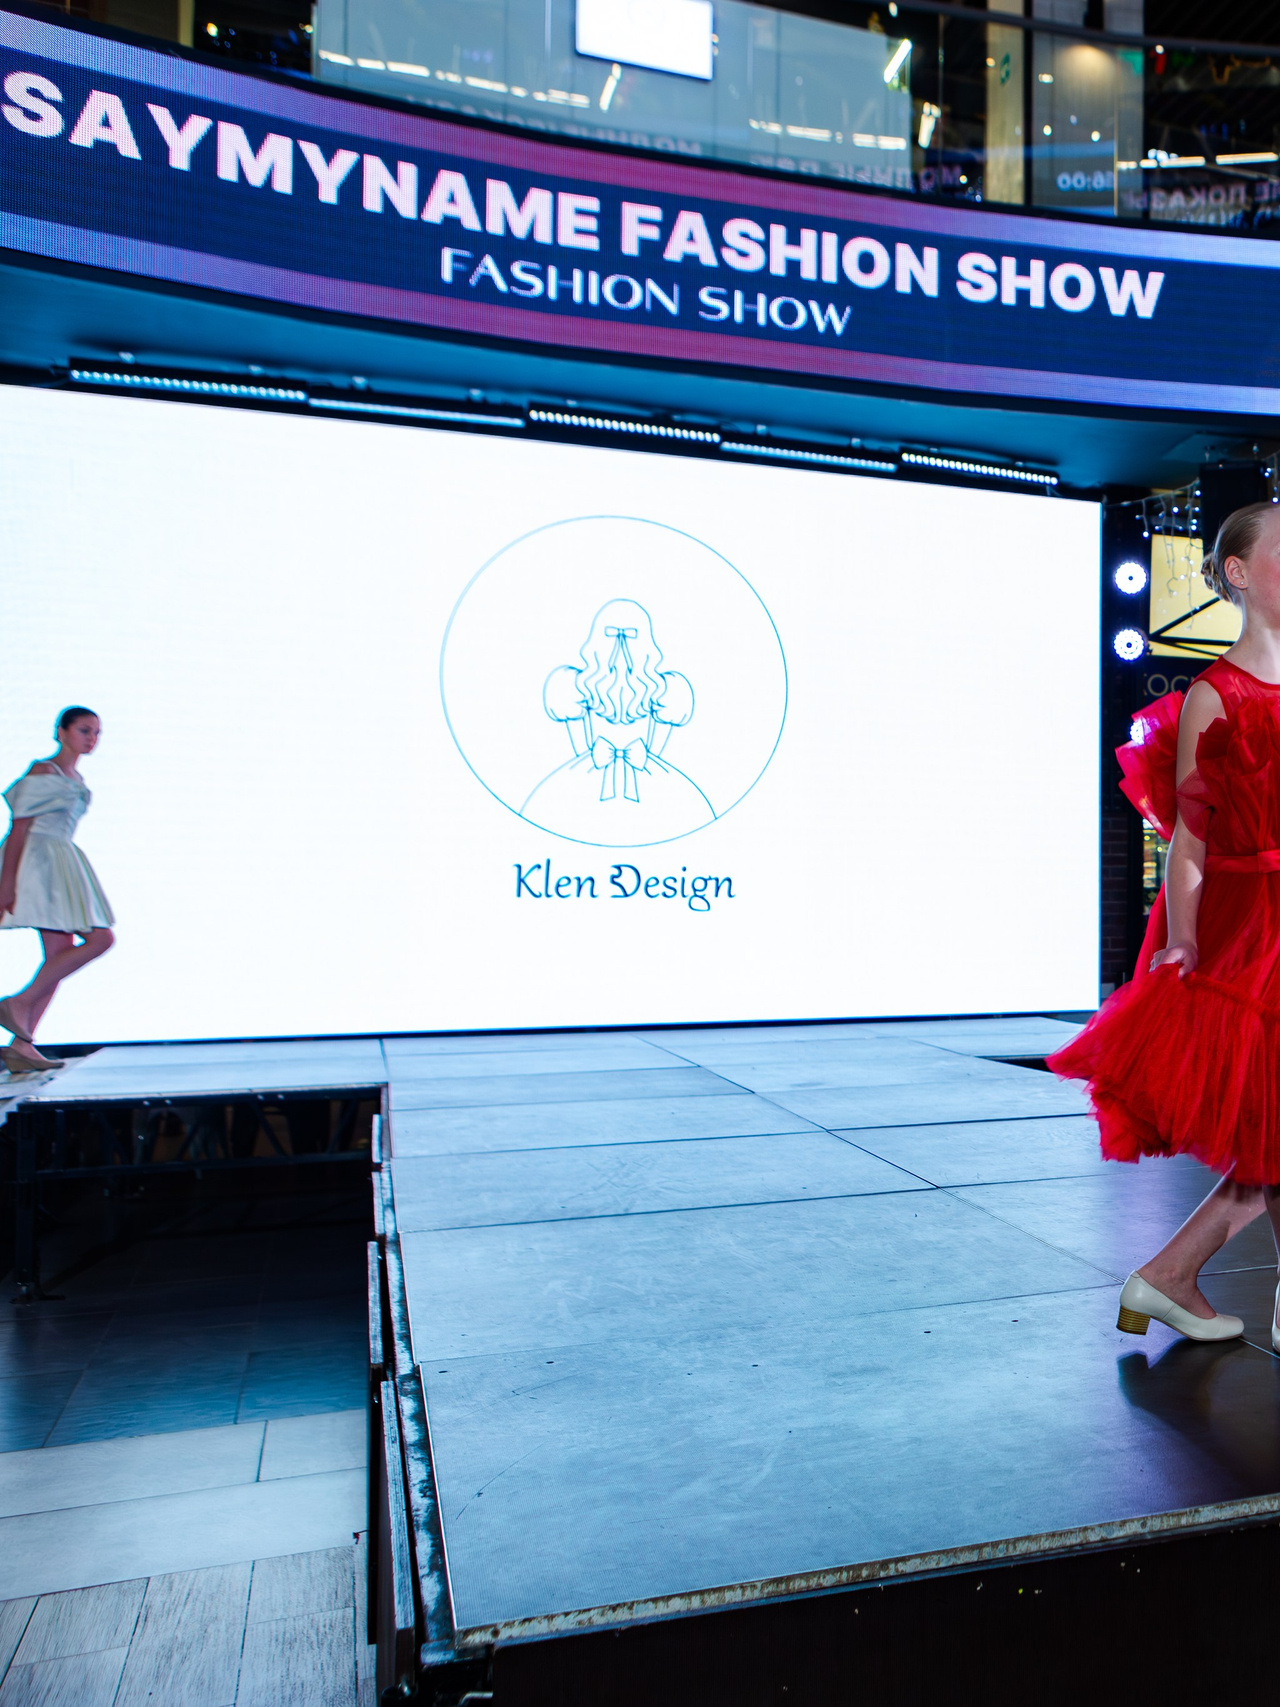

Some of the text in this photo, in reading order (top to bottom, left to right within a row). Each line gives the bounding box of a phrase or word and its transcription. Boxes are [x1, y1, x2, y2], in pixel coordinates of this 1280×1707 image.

[1, 70, 601, 252] SAYMYNAME
[620, 200, 941, 299] FASHION
[955, 251, 1165, 320] SHOW
[441, 247, 853, 337] FASHION SHOW
[512, 857, 737, 913] Klen Design
